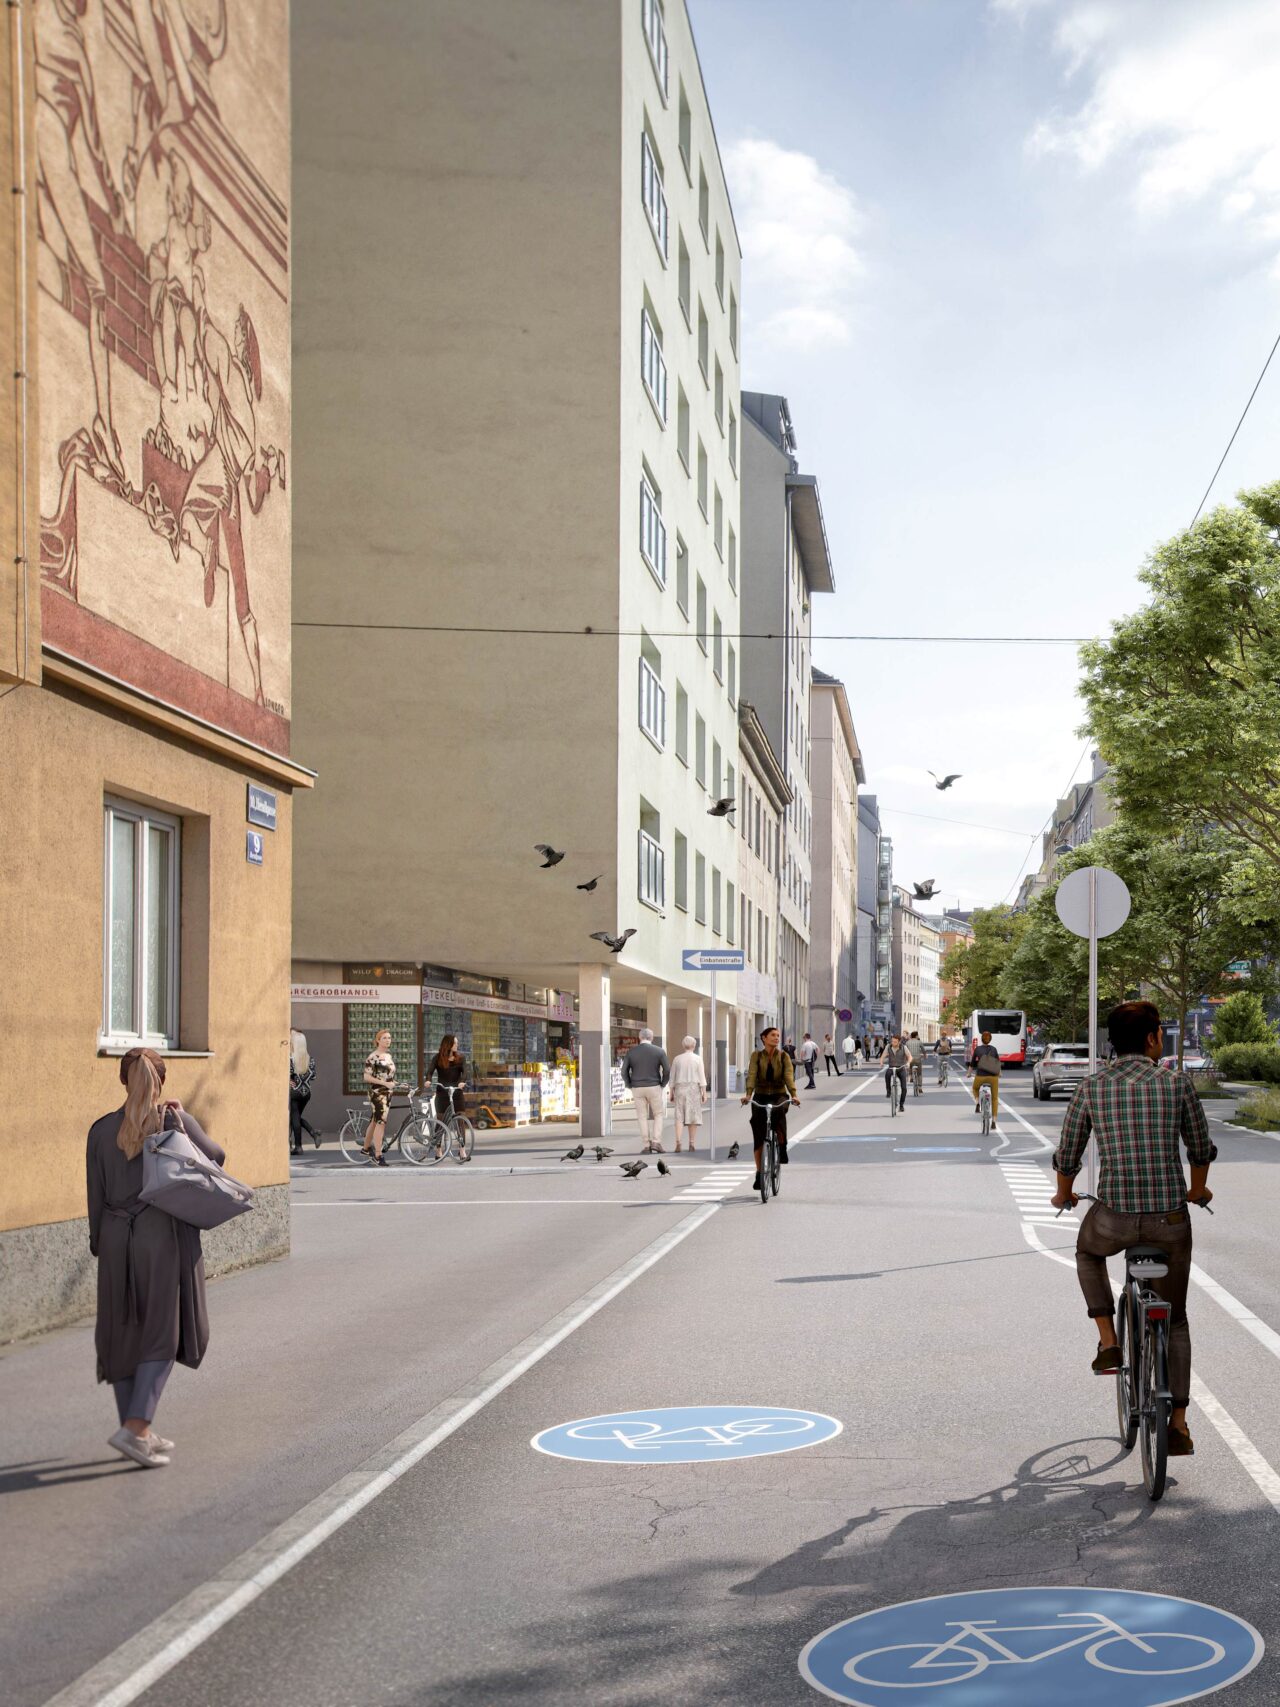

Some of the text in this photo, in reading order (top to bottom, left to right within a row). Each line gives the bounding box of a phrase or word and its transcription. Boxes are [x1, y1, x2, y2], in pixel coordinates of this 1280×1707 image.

[253, 834, 261, 853] 9
[429, 989, 454, 1002] TEKEL
[553, 1004, 572, 1016] TEKEL
